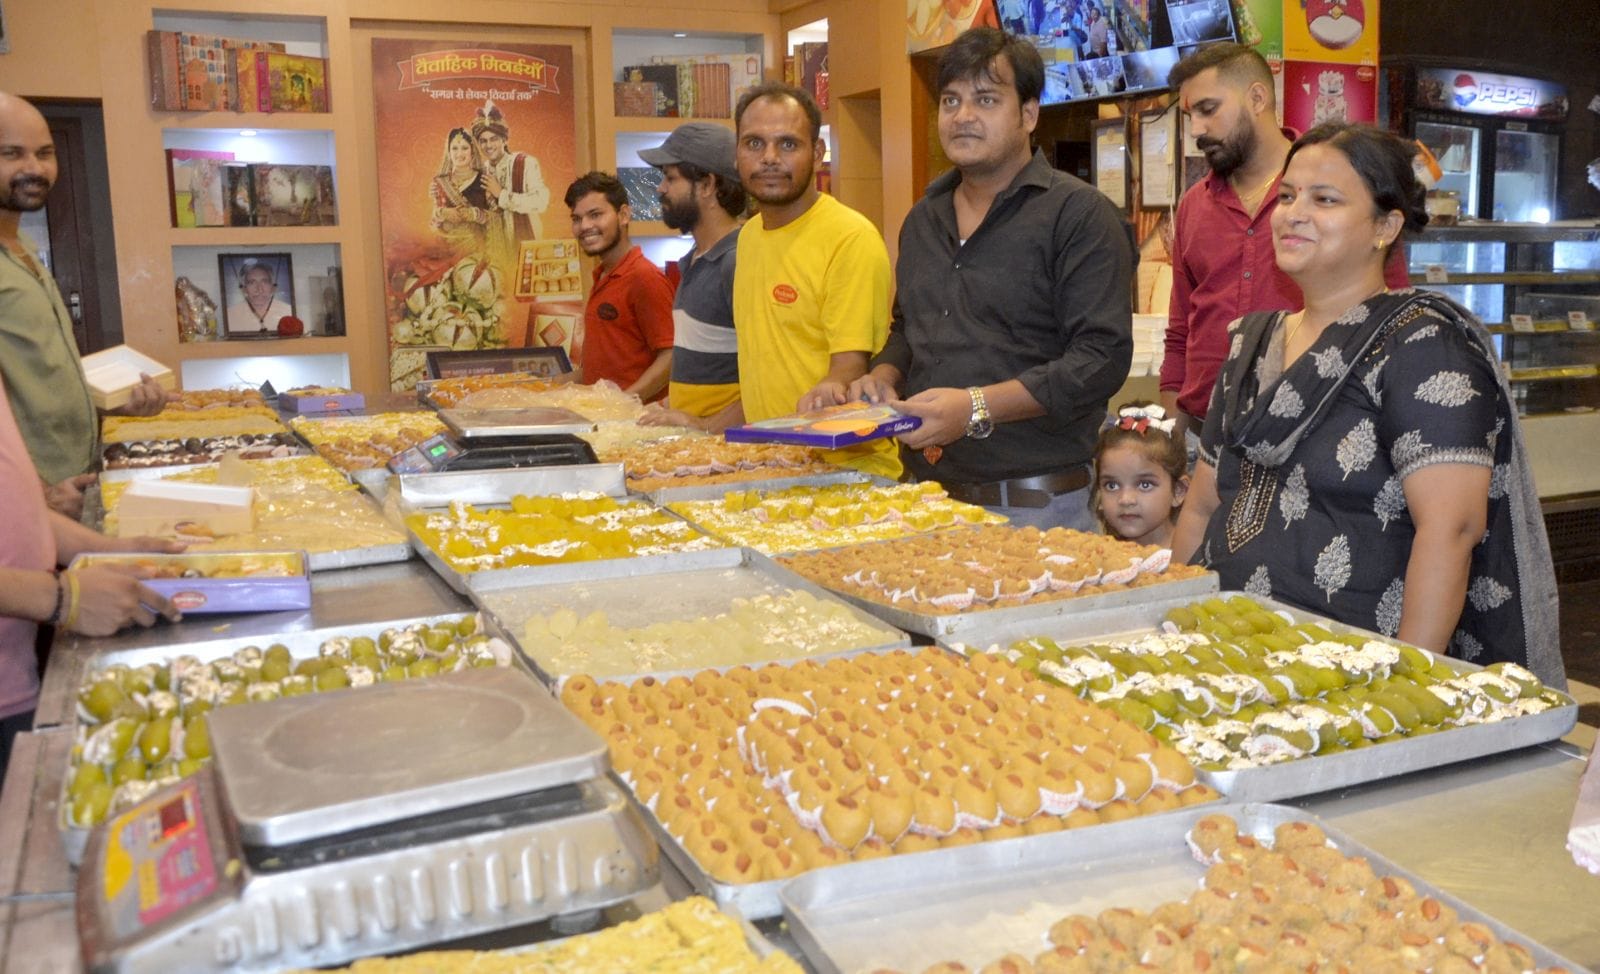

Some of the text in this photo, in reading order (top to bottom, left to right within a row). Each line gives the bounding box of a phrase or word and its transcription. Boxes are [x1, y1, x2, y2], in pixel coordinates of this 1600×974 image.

[415, 54, 477, 75] वैवाहिक
[455, 88, 464, 99] से
[465, 87, 488, 99] लेकर
[1479, 81, 1538, 107] PEPSI
